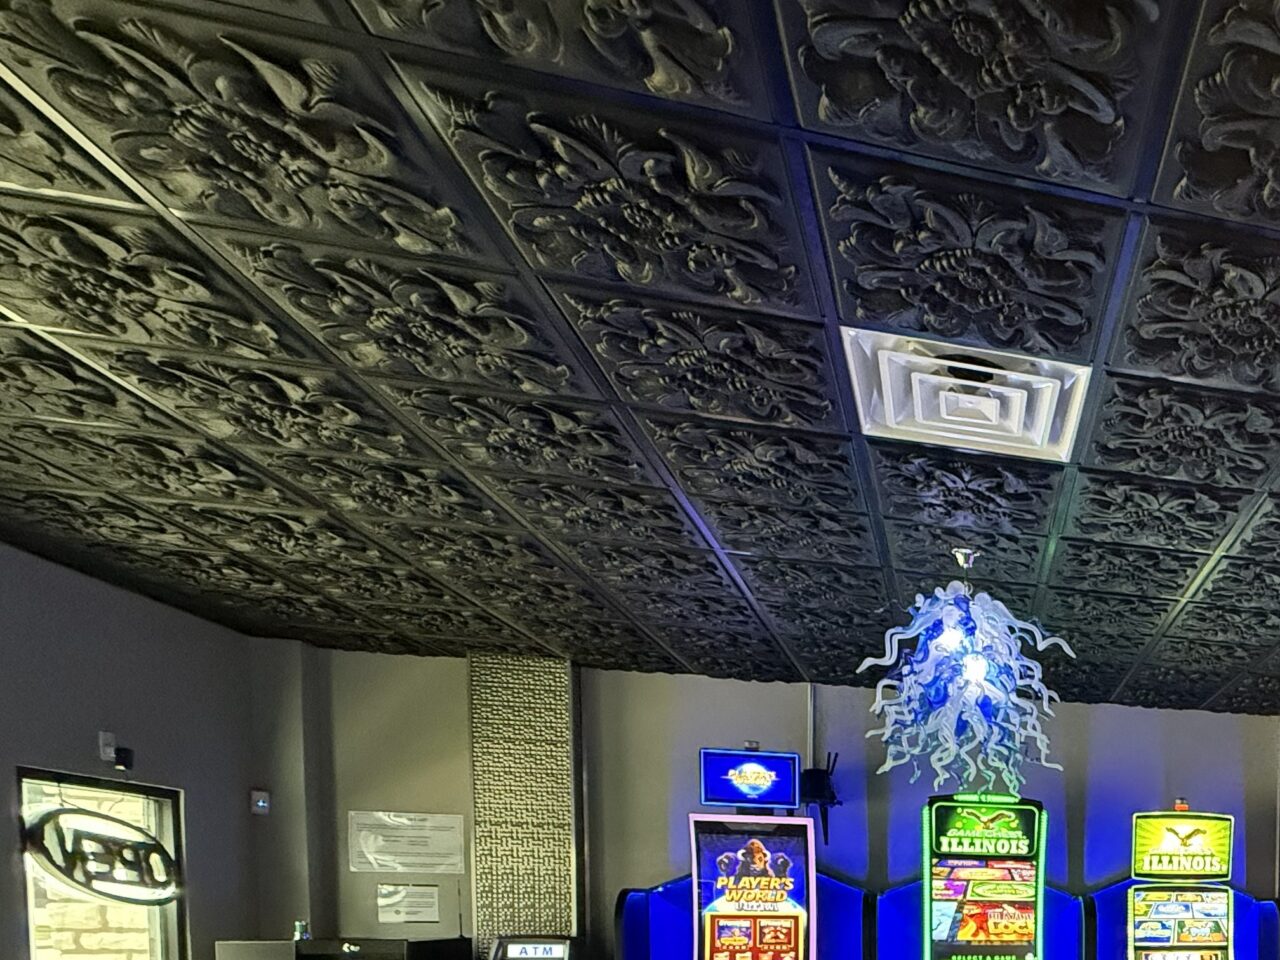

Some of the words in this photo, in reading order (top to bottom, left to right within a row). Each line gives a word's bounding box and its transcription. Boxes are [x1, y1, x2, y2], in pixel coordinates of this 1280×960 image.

[940, 836, 1029, 854] ILLINOIS
[1143, 855, 1221, 872] ILLINOIS
[716, 876, 795, 890] PLAYER'S
[725, 889, 787, 902] WORLD
[519, 947, 553, 956] ATM
